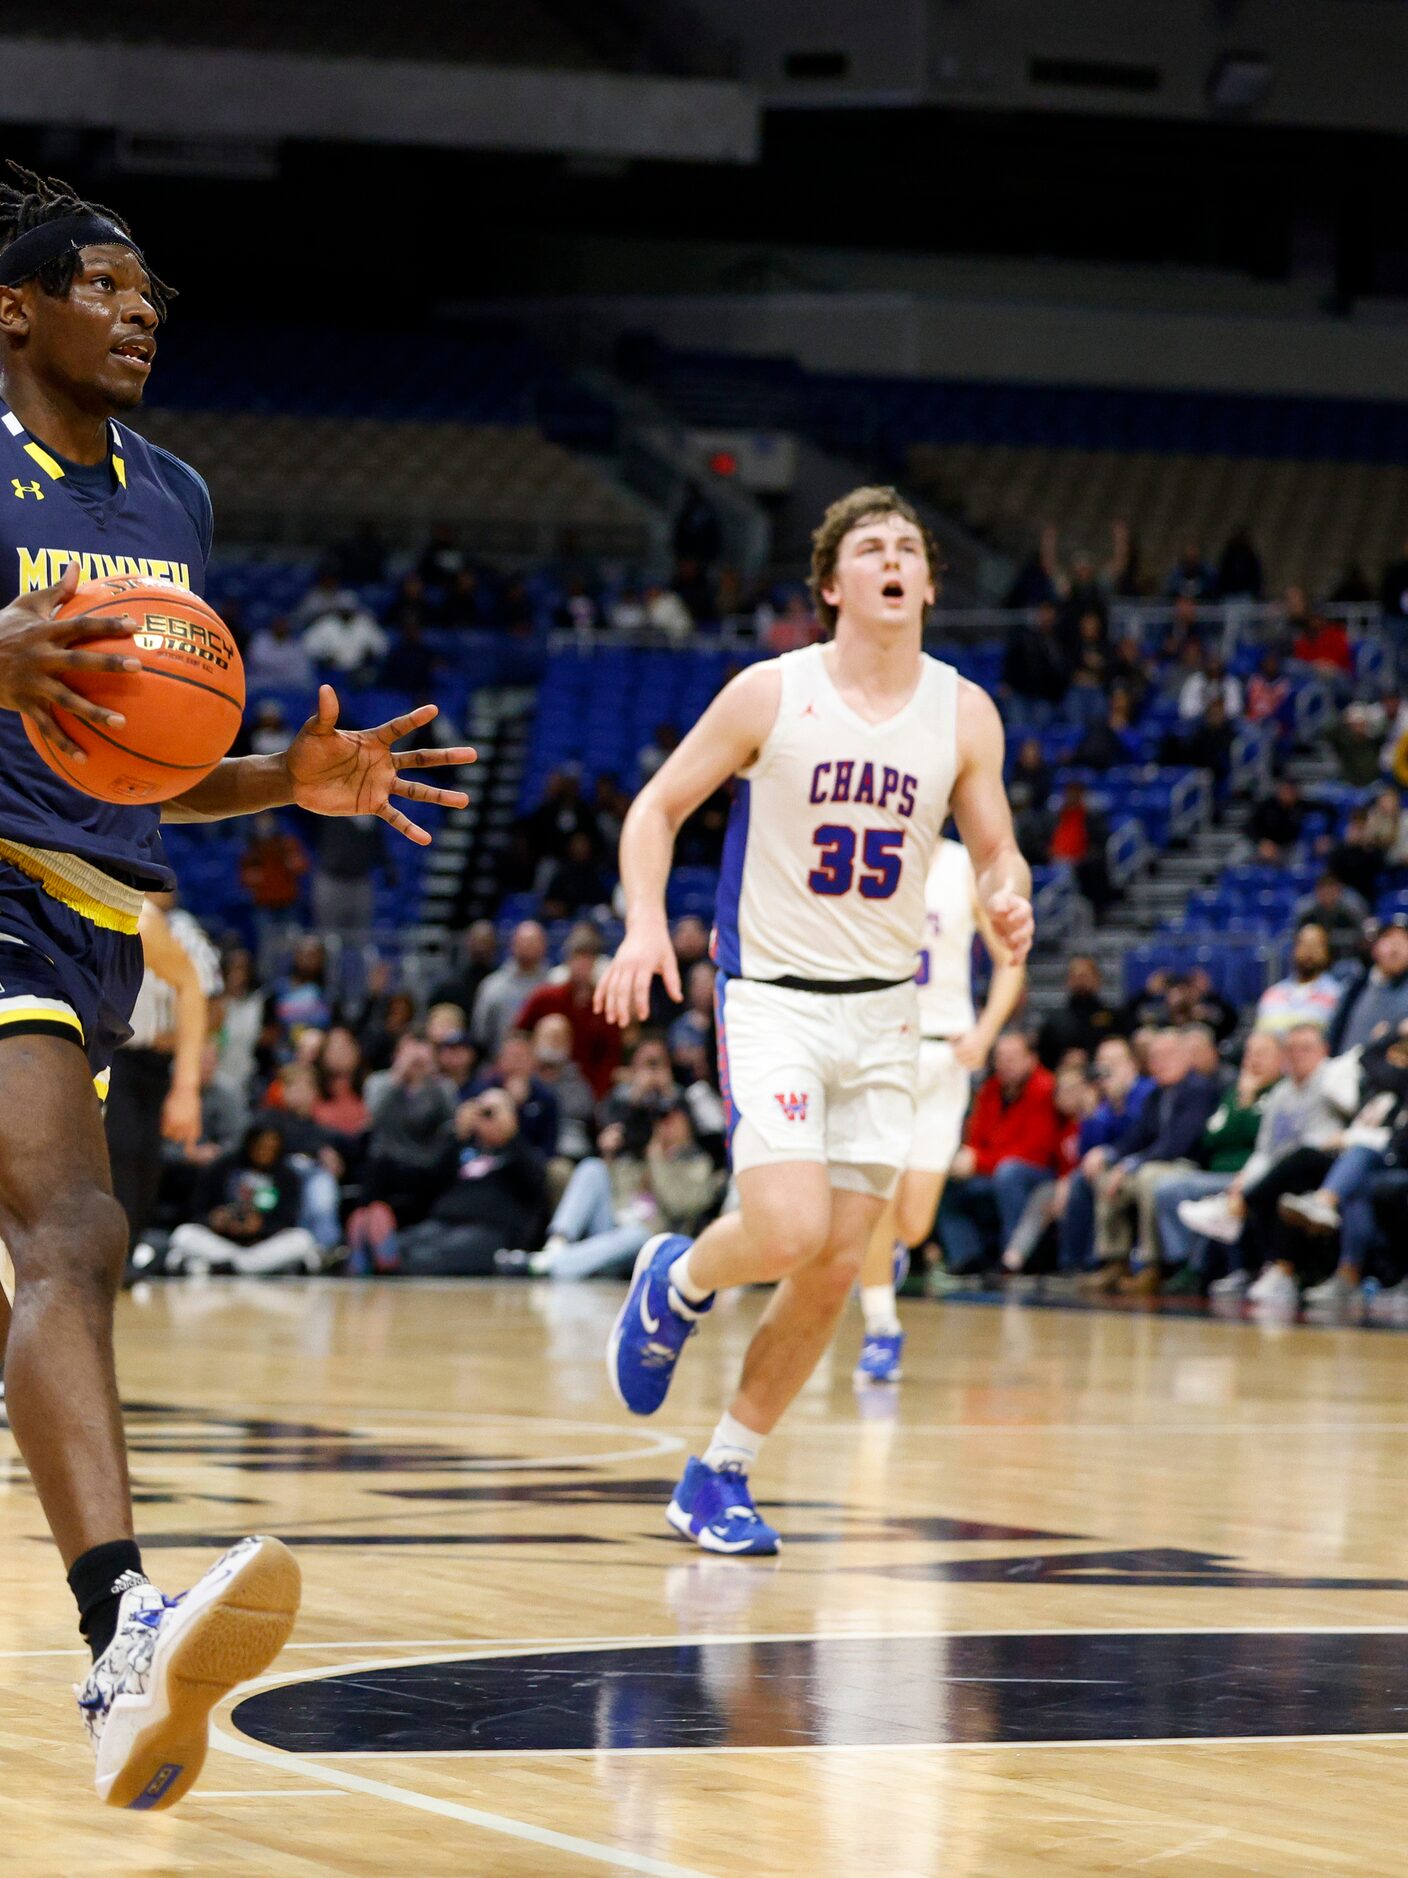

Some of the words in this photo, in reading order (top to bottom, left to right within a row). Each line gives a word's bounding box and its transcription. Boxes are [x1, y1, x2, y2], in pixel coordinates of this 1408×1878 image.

[124, 612, 234, 660] EGACY
[809, 761, 918, 818] CHAPS
[808, 824, 905, 899] 35
[774, 1090, 809, 1121] W
